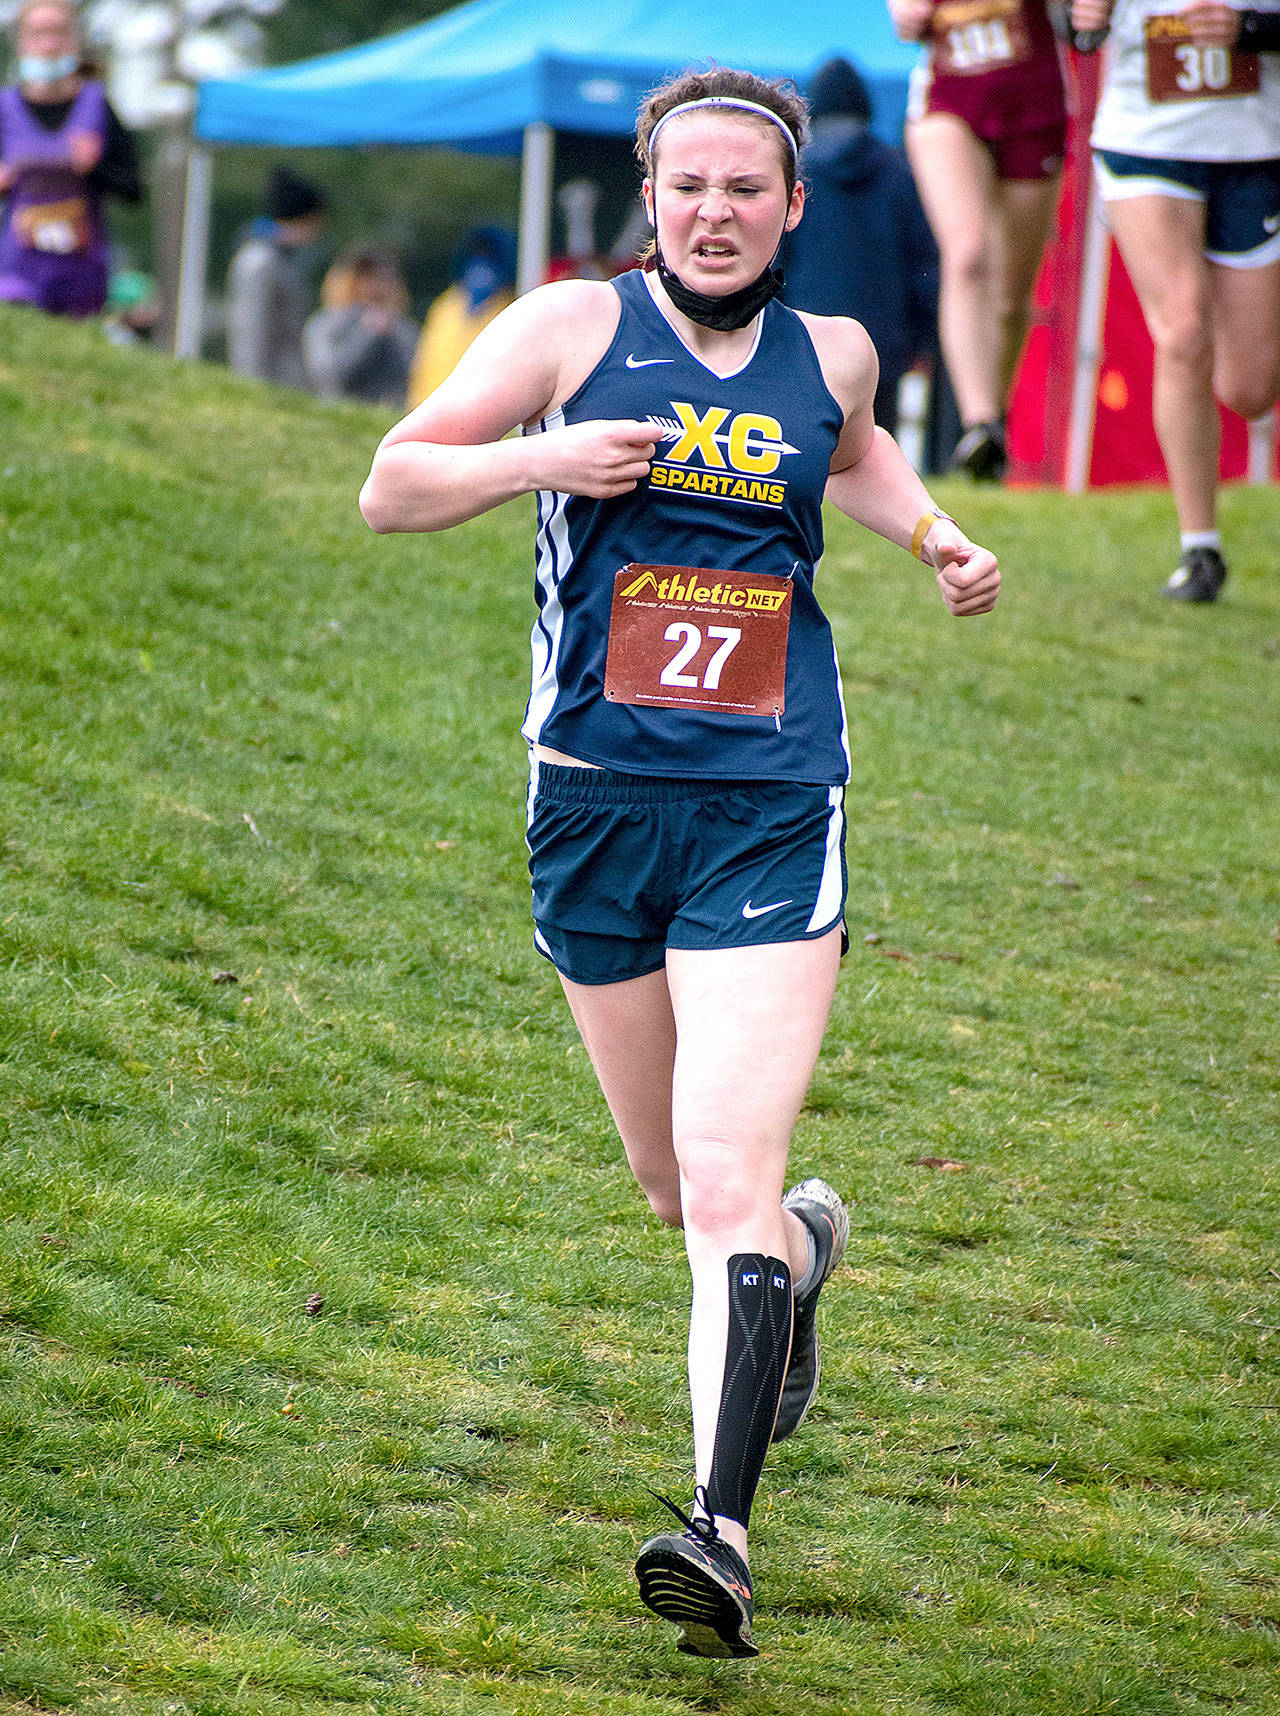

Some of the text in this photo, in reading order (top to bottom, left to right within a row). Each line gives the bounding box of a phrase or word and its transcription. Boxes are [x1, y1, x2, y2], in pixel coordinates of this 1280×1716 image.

[1176, 44, 1231, 91] 30
[664, 401, 783, 475] XC
[650, 466, 785, 504] SPARTANS
[751, 593, 781, 608] NET
[659, 621, 742, 690] 27
[742, 1274, 759, 1286] KT
[773, 1276, 785, 1289] KT
